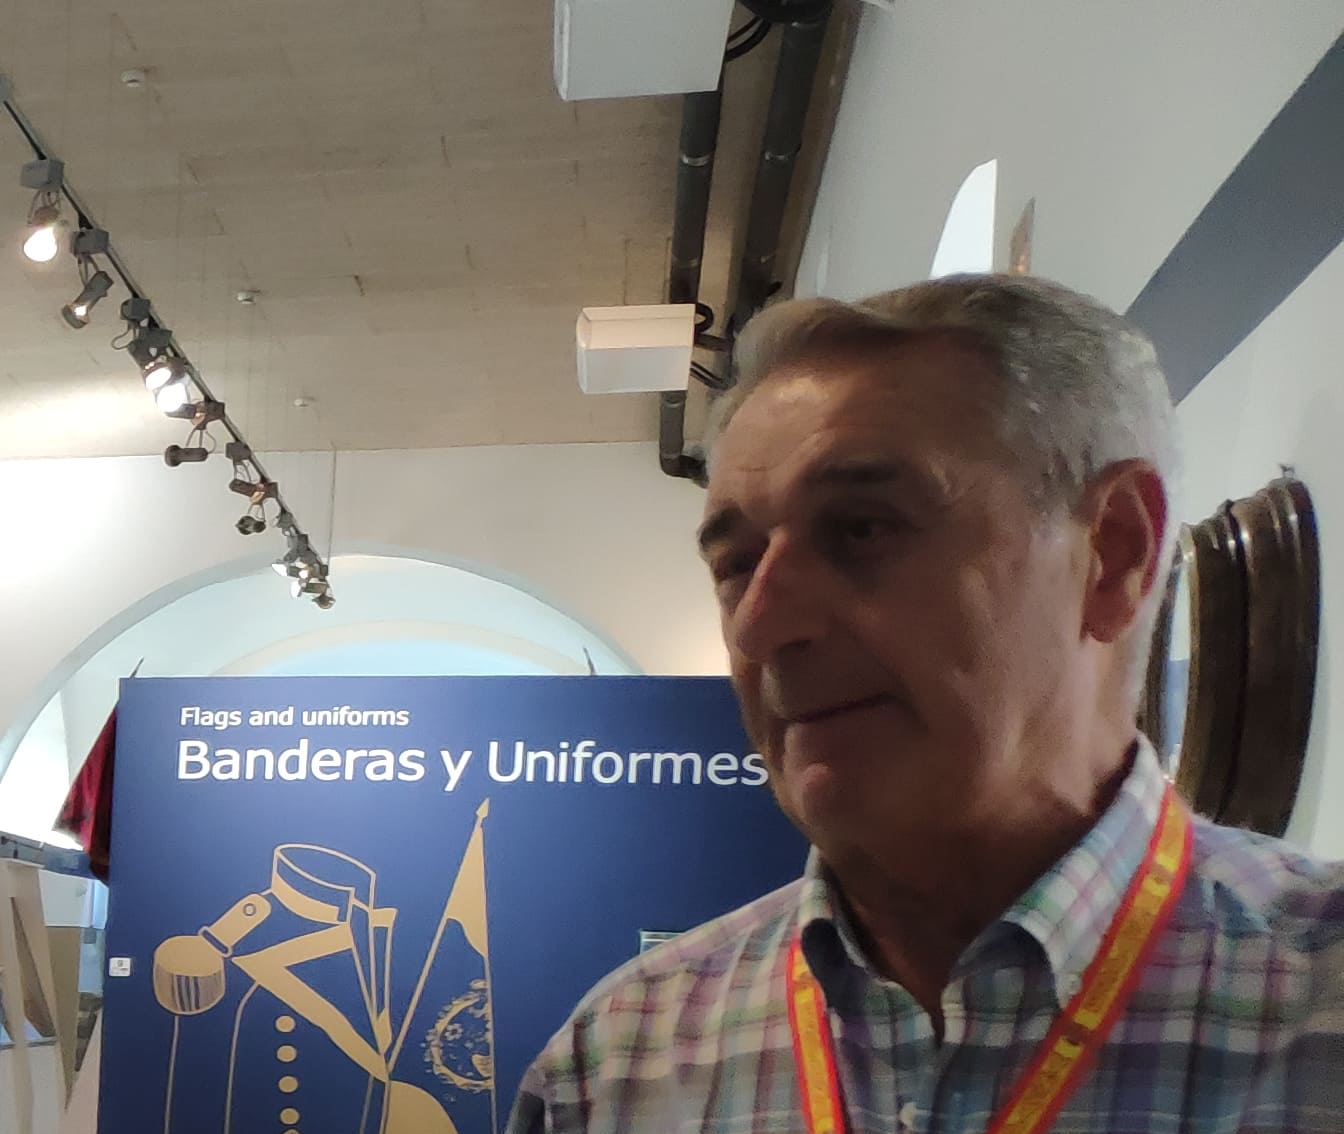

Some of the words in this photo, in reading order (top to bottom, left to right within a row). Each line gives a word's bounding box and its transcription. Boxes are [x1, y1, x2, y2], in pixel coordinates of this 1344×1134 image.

[180, 705, 242, 731] Flags
[248, 706, 294, 726] and
[302, 705, 410, 726] uniforms
[176, 738, 426, 782] Banderas
[439, 750, 473, 792] y
[488, 740, 769, 786] Uniformes
